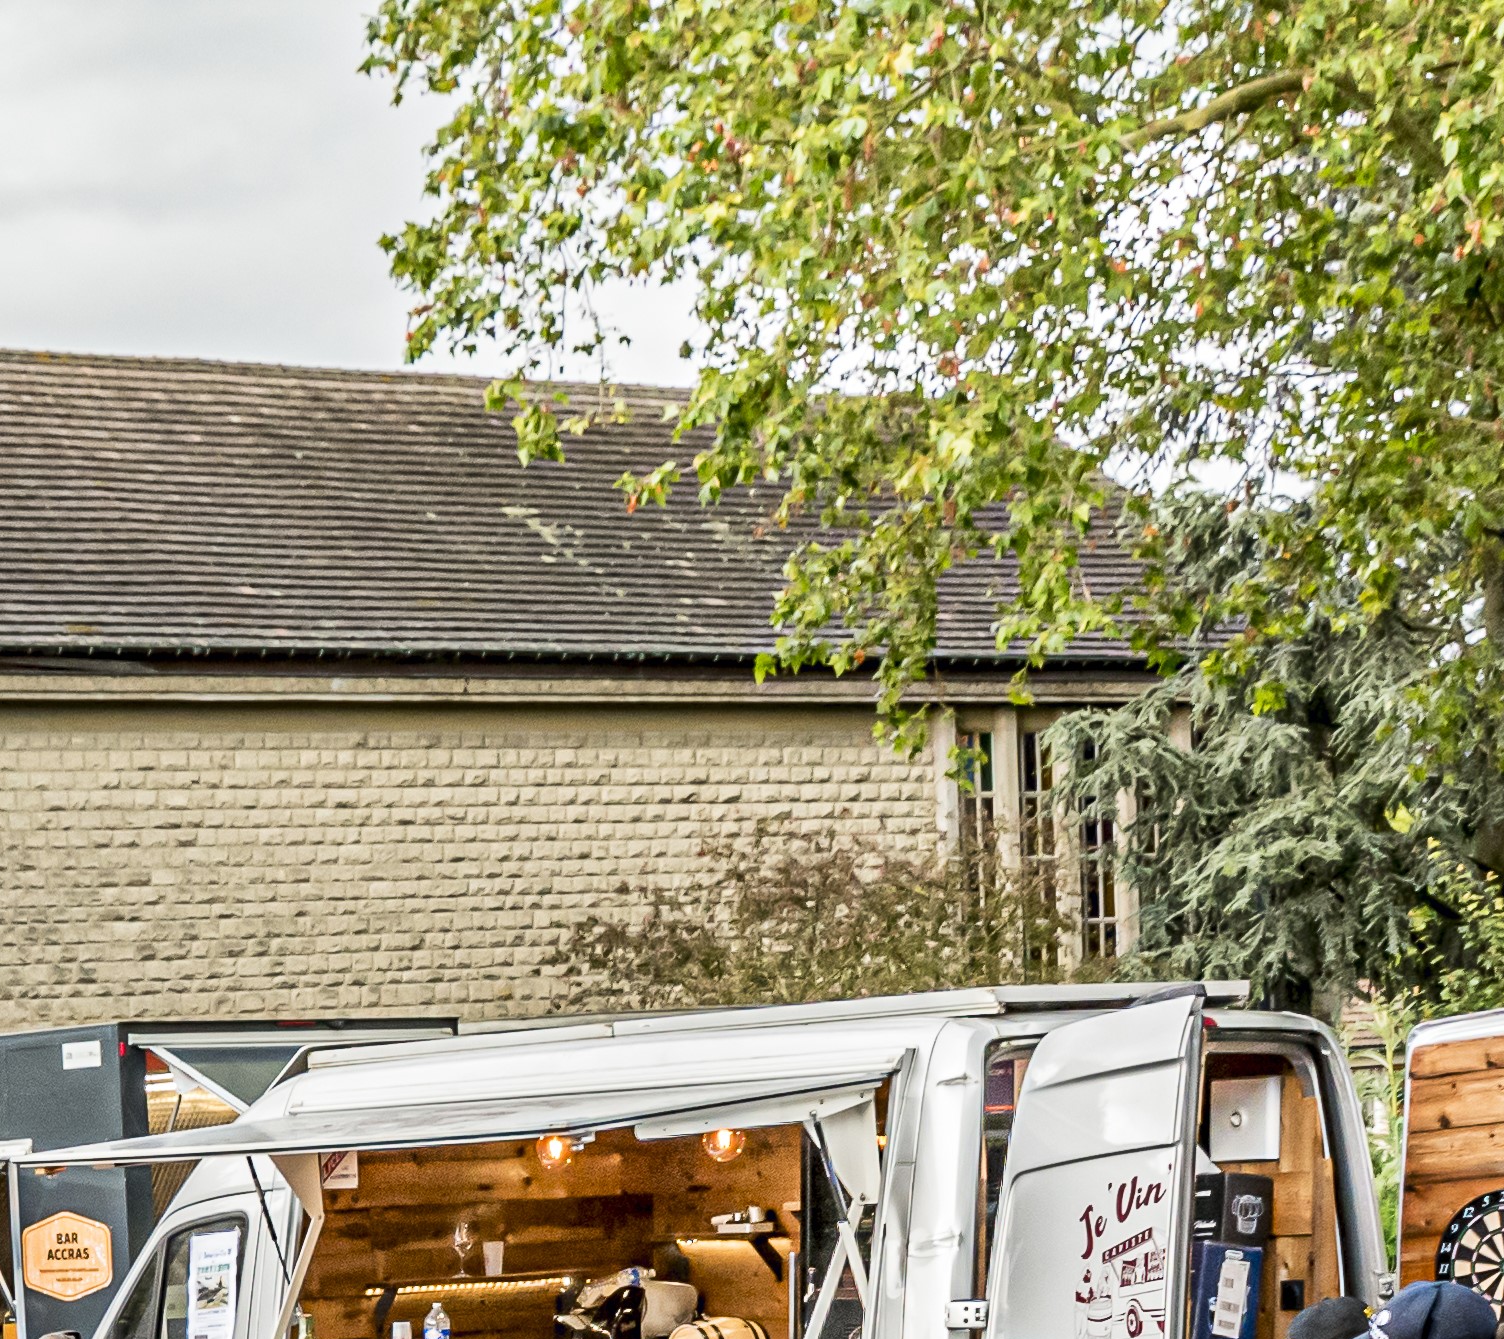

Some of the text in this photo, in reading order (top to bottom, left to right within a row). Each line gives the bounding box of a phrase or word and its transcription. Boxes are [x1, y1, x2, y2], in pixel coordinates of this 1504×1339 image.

[1481, 1195, 1490, 1207] 5
[1462, 1206, 1475, 1219] 12
[1450, 1223, 1459, 1234] 9
[56, 1232, 78, 1244] BAR
[47, 1247, 90, 1260] ACCRAS
[1440, 1242, 1452, 1253] 14
[1438, 1263, 1449, 1274] 11
